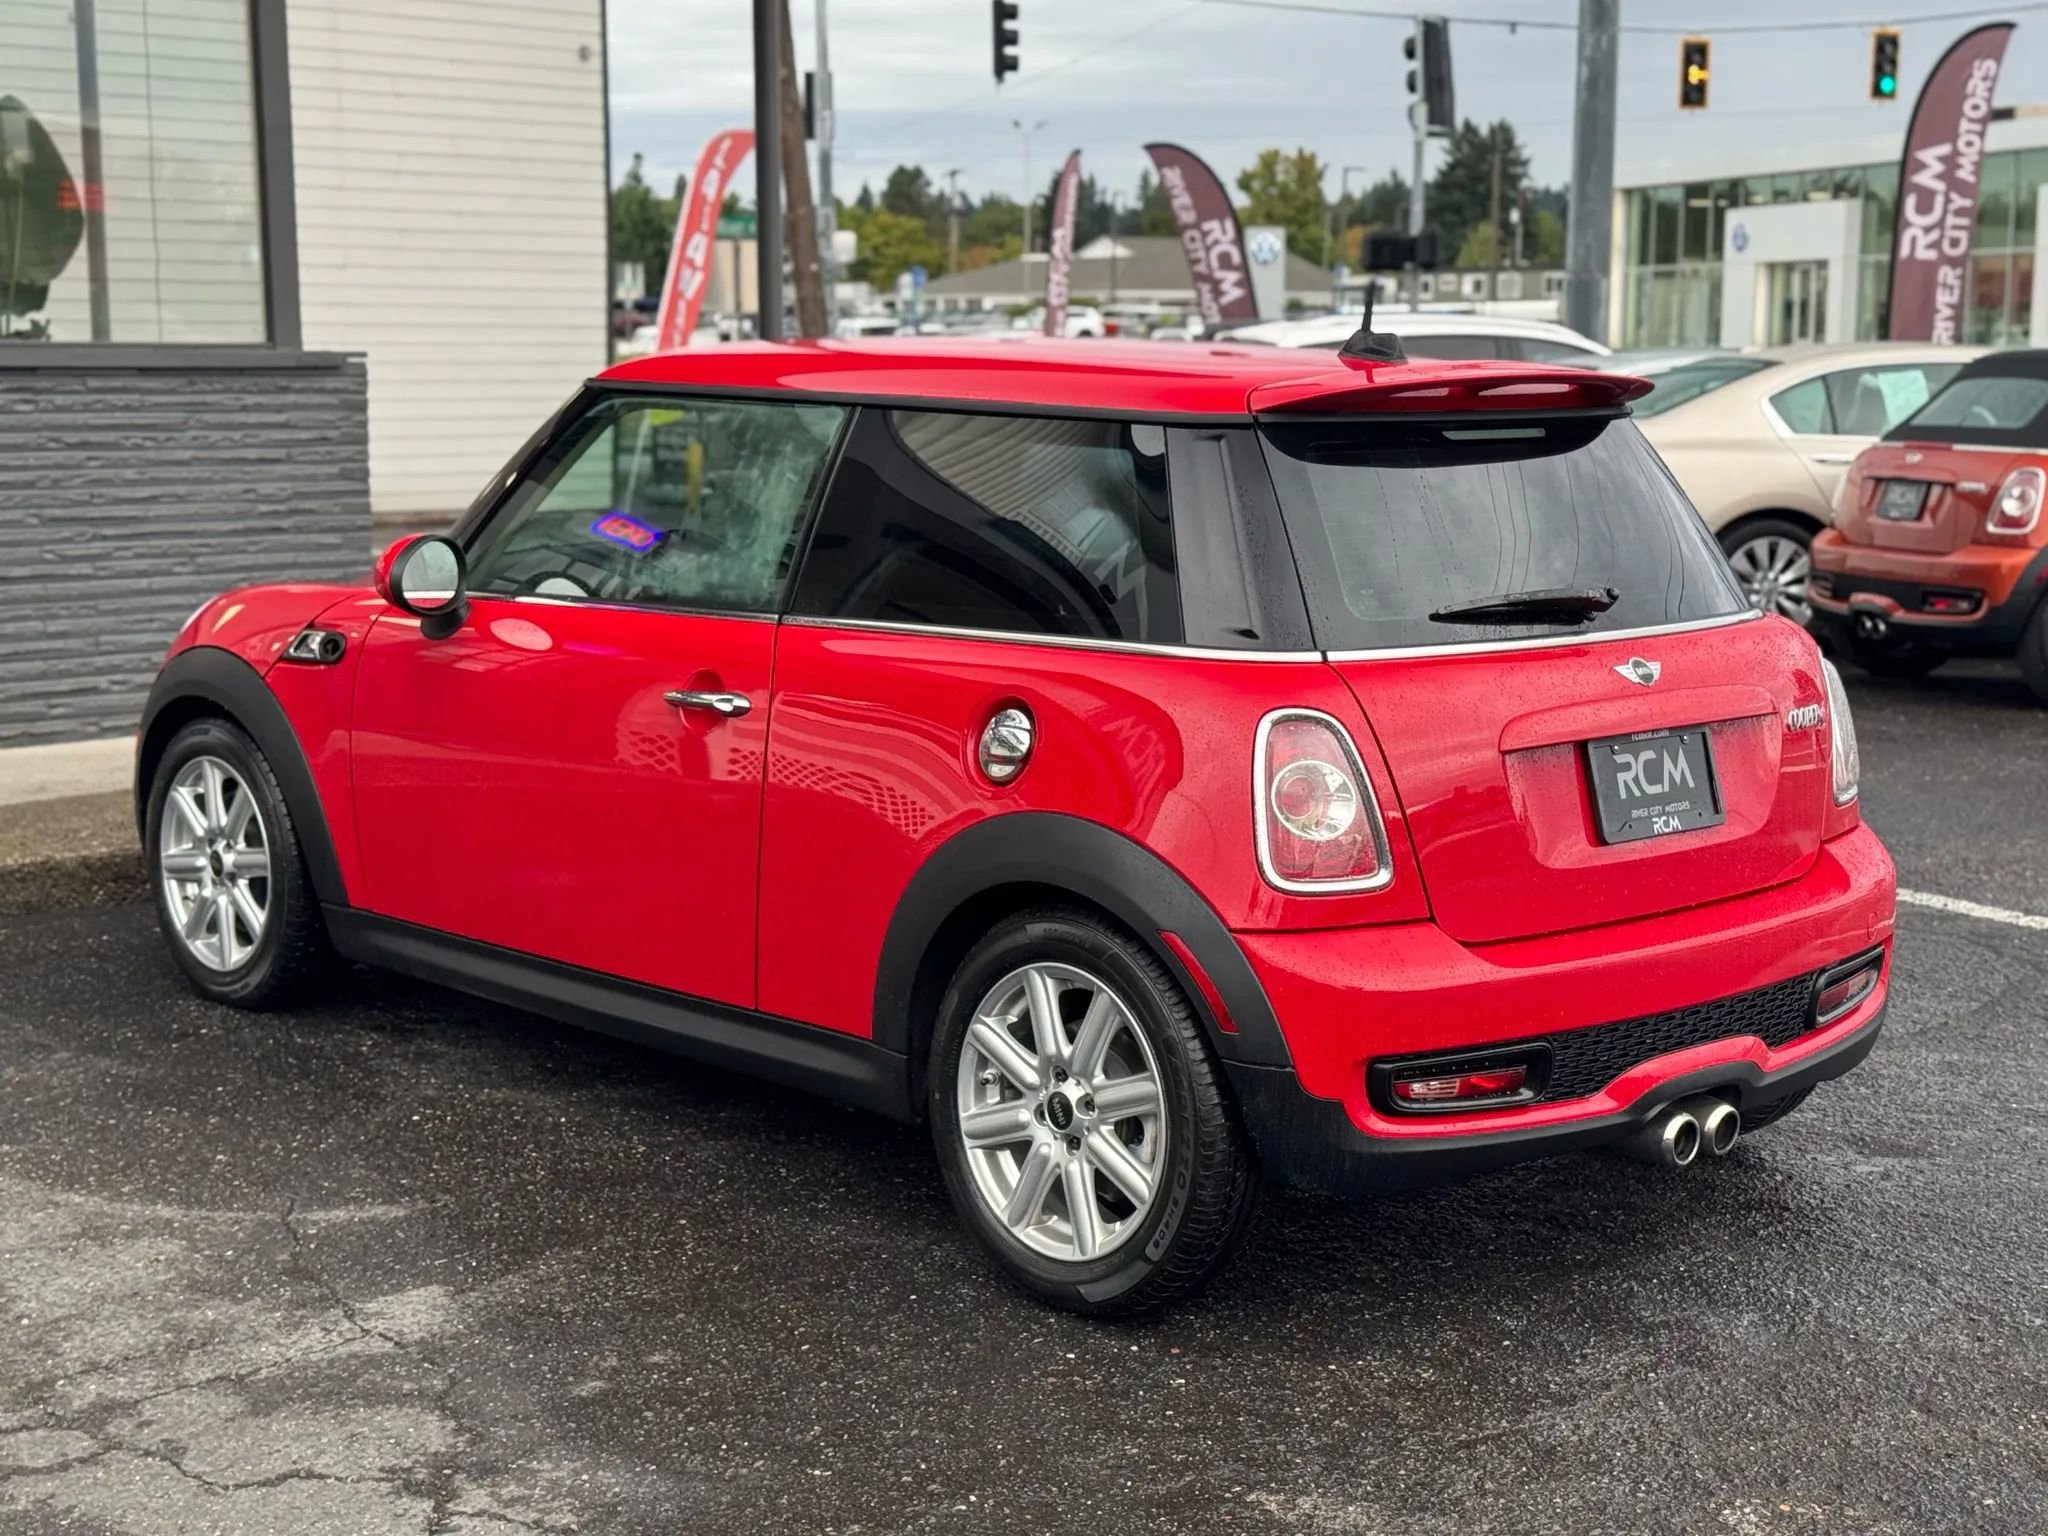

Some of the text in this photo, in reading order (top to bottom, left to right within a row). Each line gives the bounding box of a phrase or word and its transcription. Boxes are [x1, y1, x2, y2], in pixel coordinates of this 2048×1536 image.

[1900, 141, 1953, 261] RCM
[1931, 58, 1999, 346] RIVER CITY MOTORS
[1181, 228, 1210, 275] CITY
[1201, 217, 1247, 307] RCM
[1612, 746, 1695, 800] RCM
[1631, 800, 1690, 819] RIVER CITY MOTORS
[1651, 815, 1682, 835] RCM
[1052, 1097, 1066, 1126] MINI
